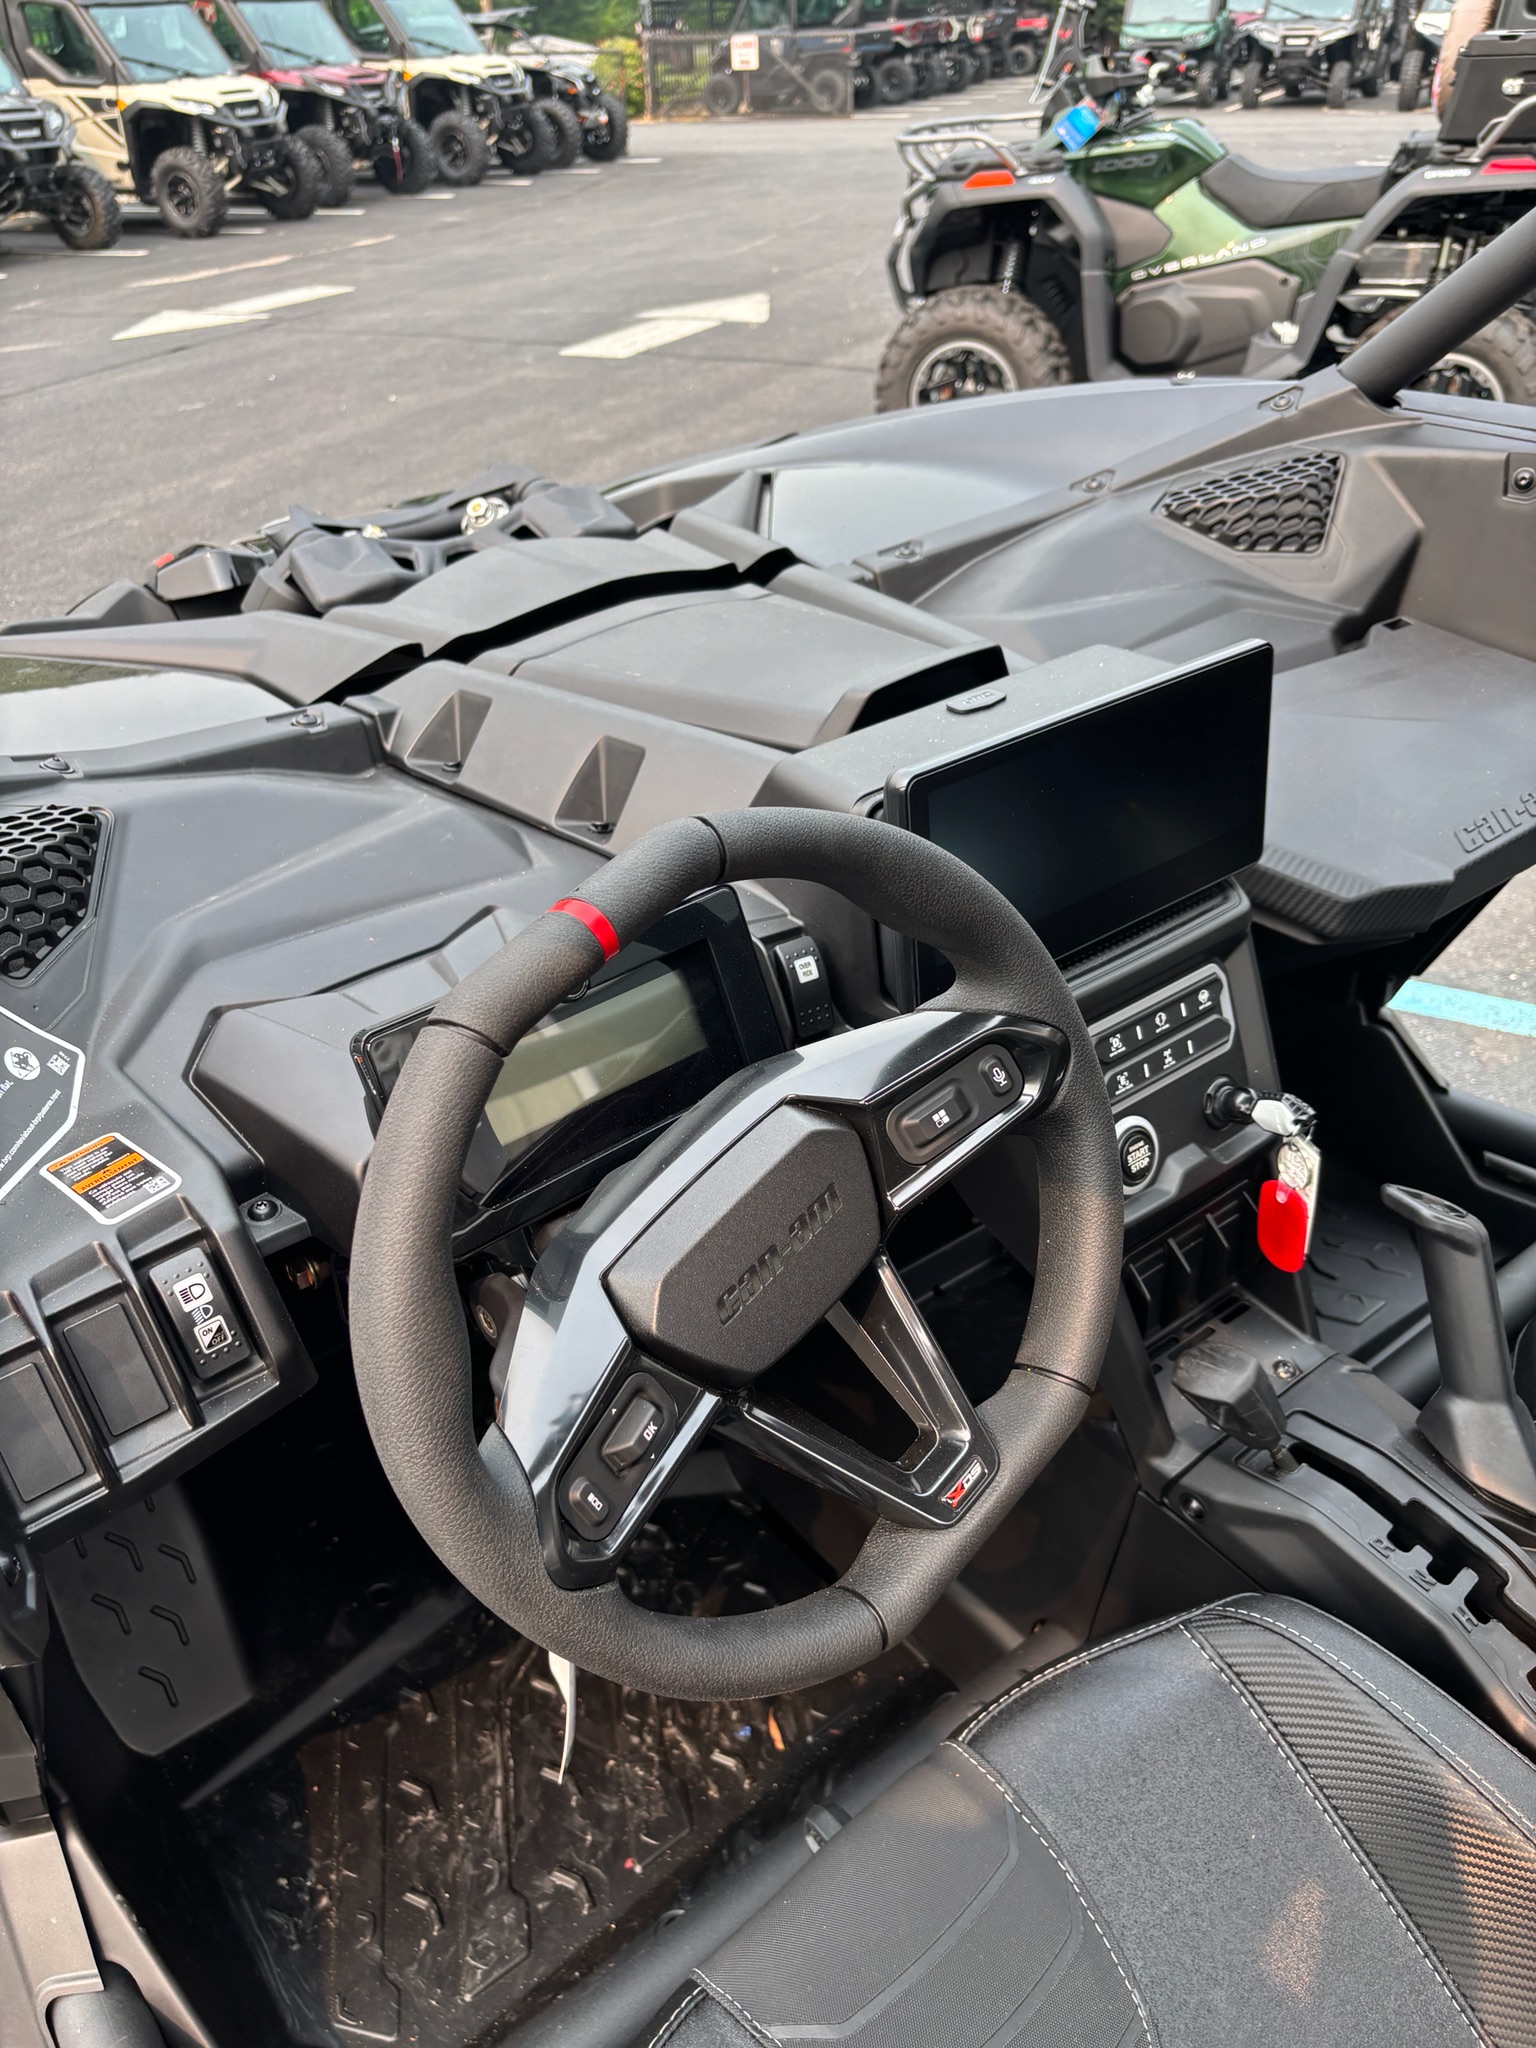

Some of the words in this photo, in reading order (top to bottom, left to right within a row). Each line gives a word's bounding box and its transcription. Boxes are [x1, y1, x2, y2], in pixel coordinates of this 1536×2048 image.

[1093, 154, 1159, 173] 1000
[1130, 236, 1267, 281] OVERLAND
[799, 961, 812, 970] OVER
[802, 969, 814, 977] RIDE
[1127, 1144, 1149, 1163] START
[1131, 1157, 1150, 1173] STOP
[202, 1327, 213, 1337] ON
[212, 1333, 226, 1345] OFF
[643, 1421, 658, 1441] OK
